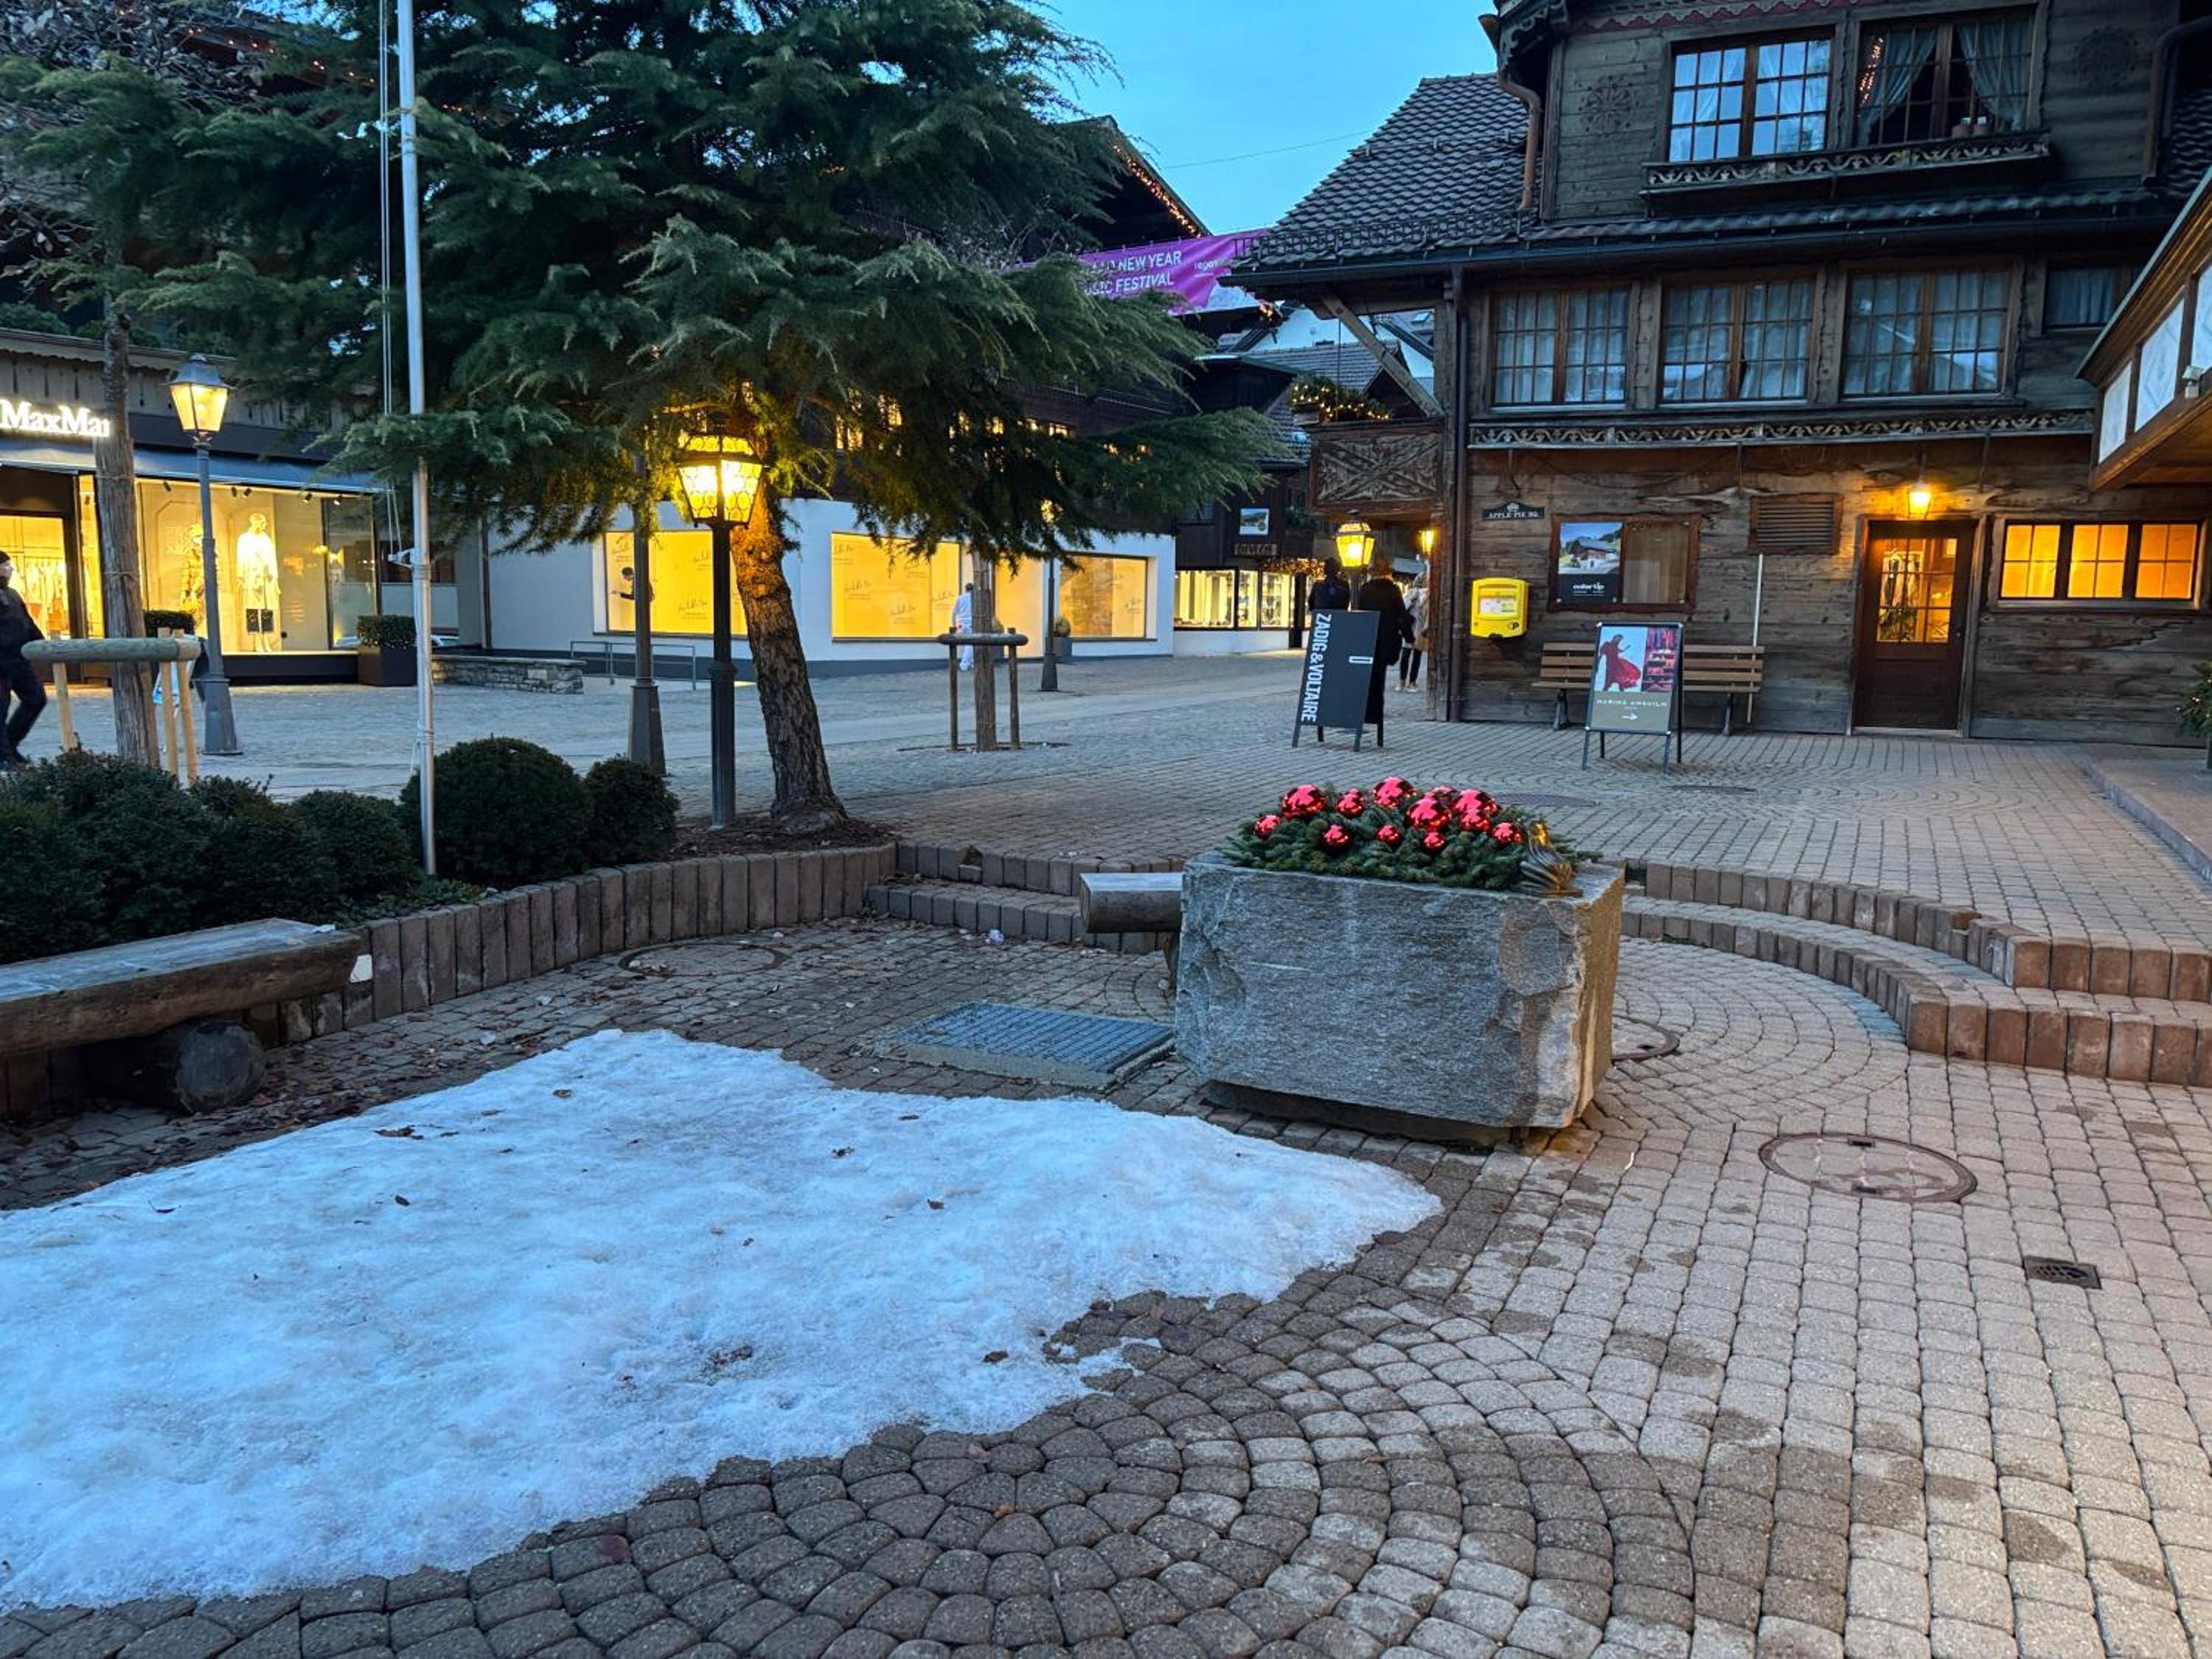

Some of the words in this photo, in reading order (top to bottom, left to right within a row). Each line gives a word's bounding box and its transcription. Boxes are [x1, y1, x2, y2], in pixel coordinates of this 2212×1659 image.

[1119, 254, 1146, 271] NEW
[1147, 251, 1182, 268] YEAR
[1084, 280, 1114, 296] USIC
[1116, 271, 1175, 293] FESTIVAL
